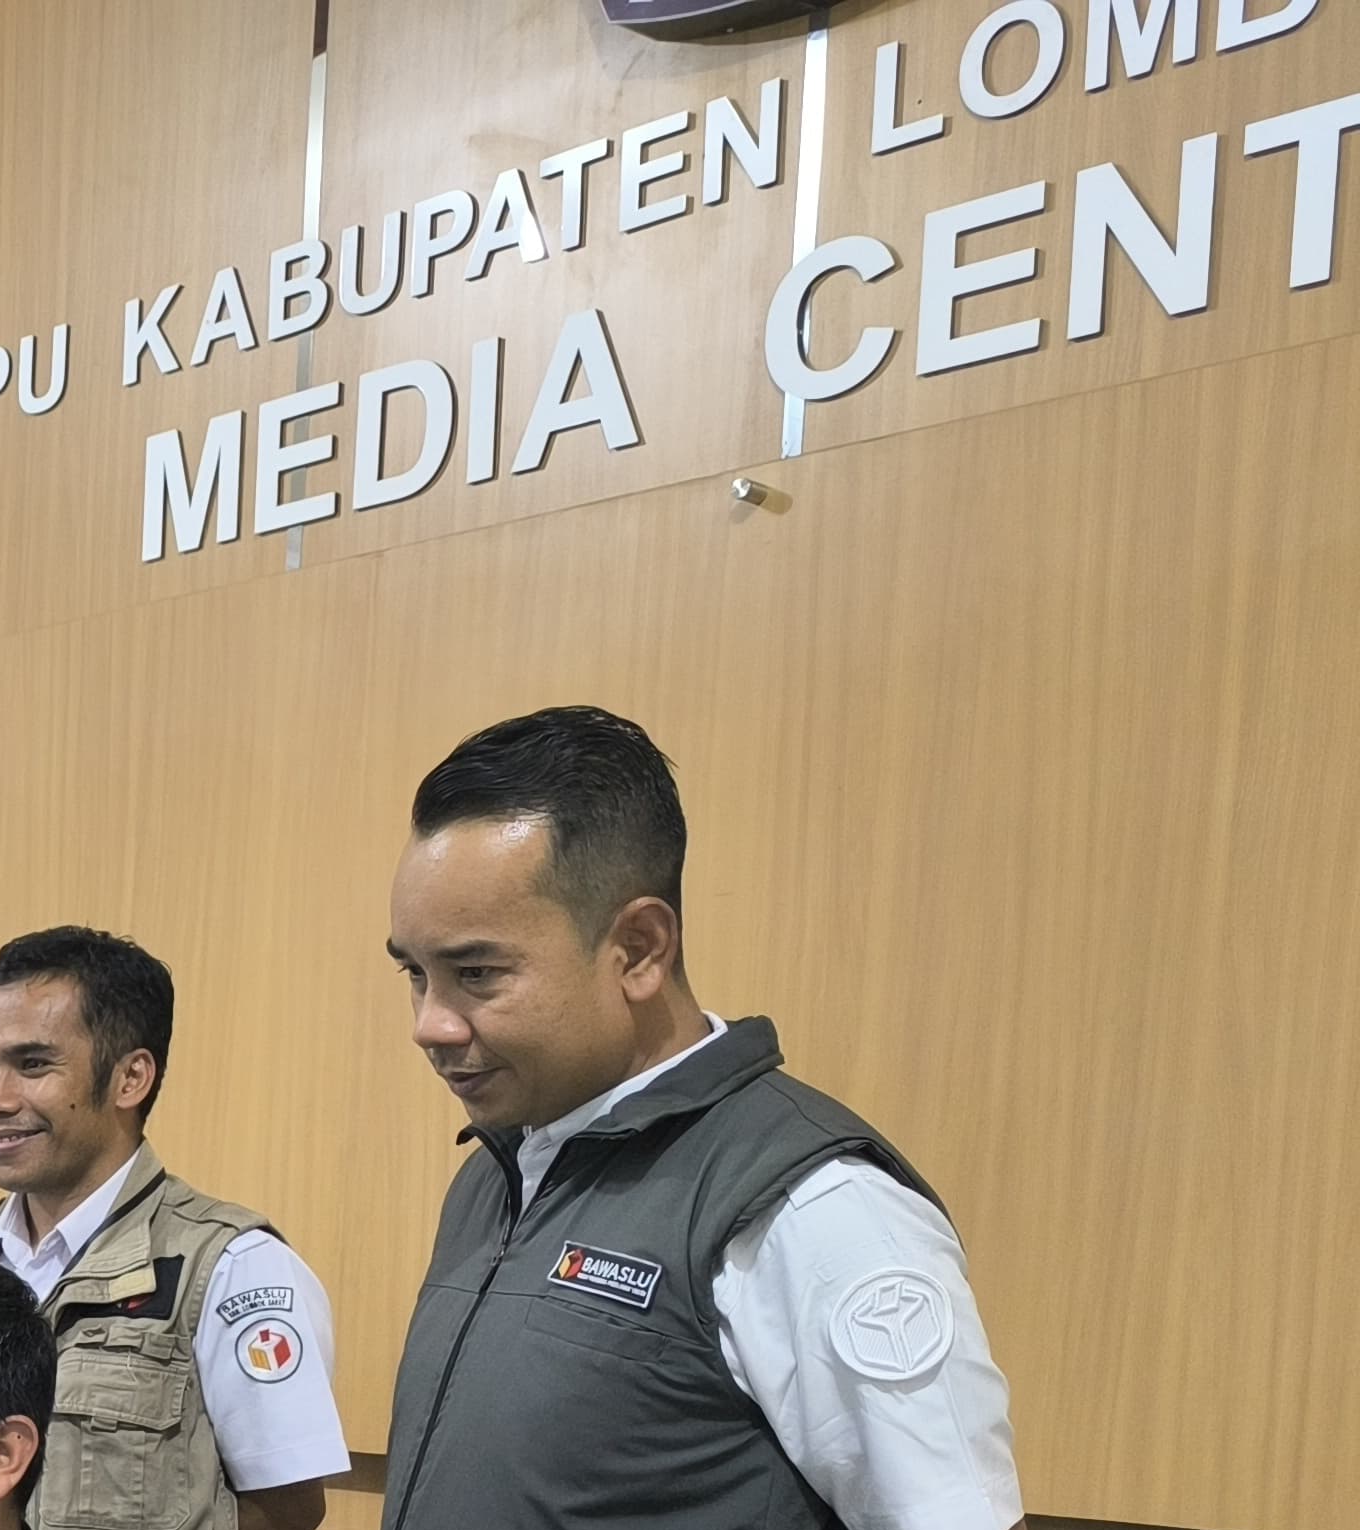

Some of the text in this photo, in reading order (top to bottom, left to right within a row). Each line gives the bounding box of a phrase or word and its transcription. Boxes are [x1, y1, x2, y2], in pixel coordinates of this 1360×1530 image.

[122, 77, 784, 387] KABUPATEN
[141, 93, 1360, 563] MEDIA CENT
[221, 1288, 287, 1313] BAWASLU
[580, 1256, 653, 1289] BAWASLU
